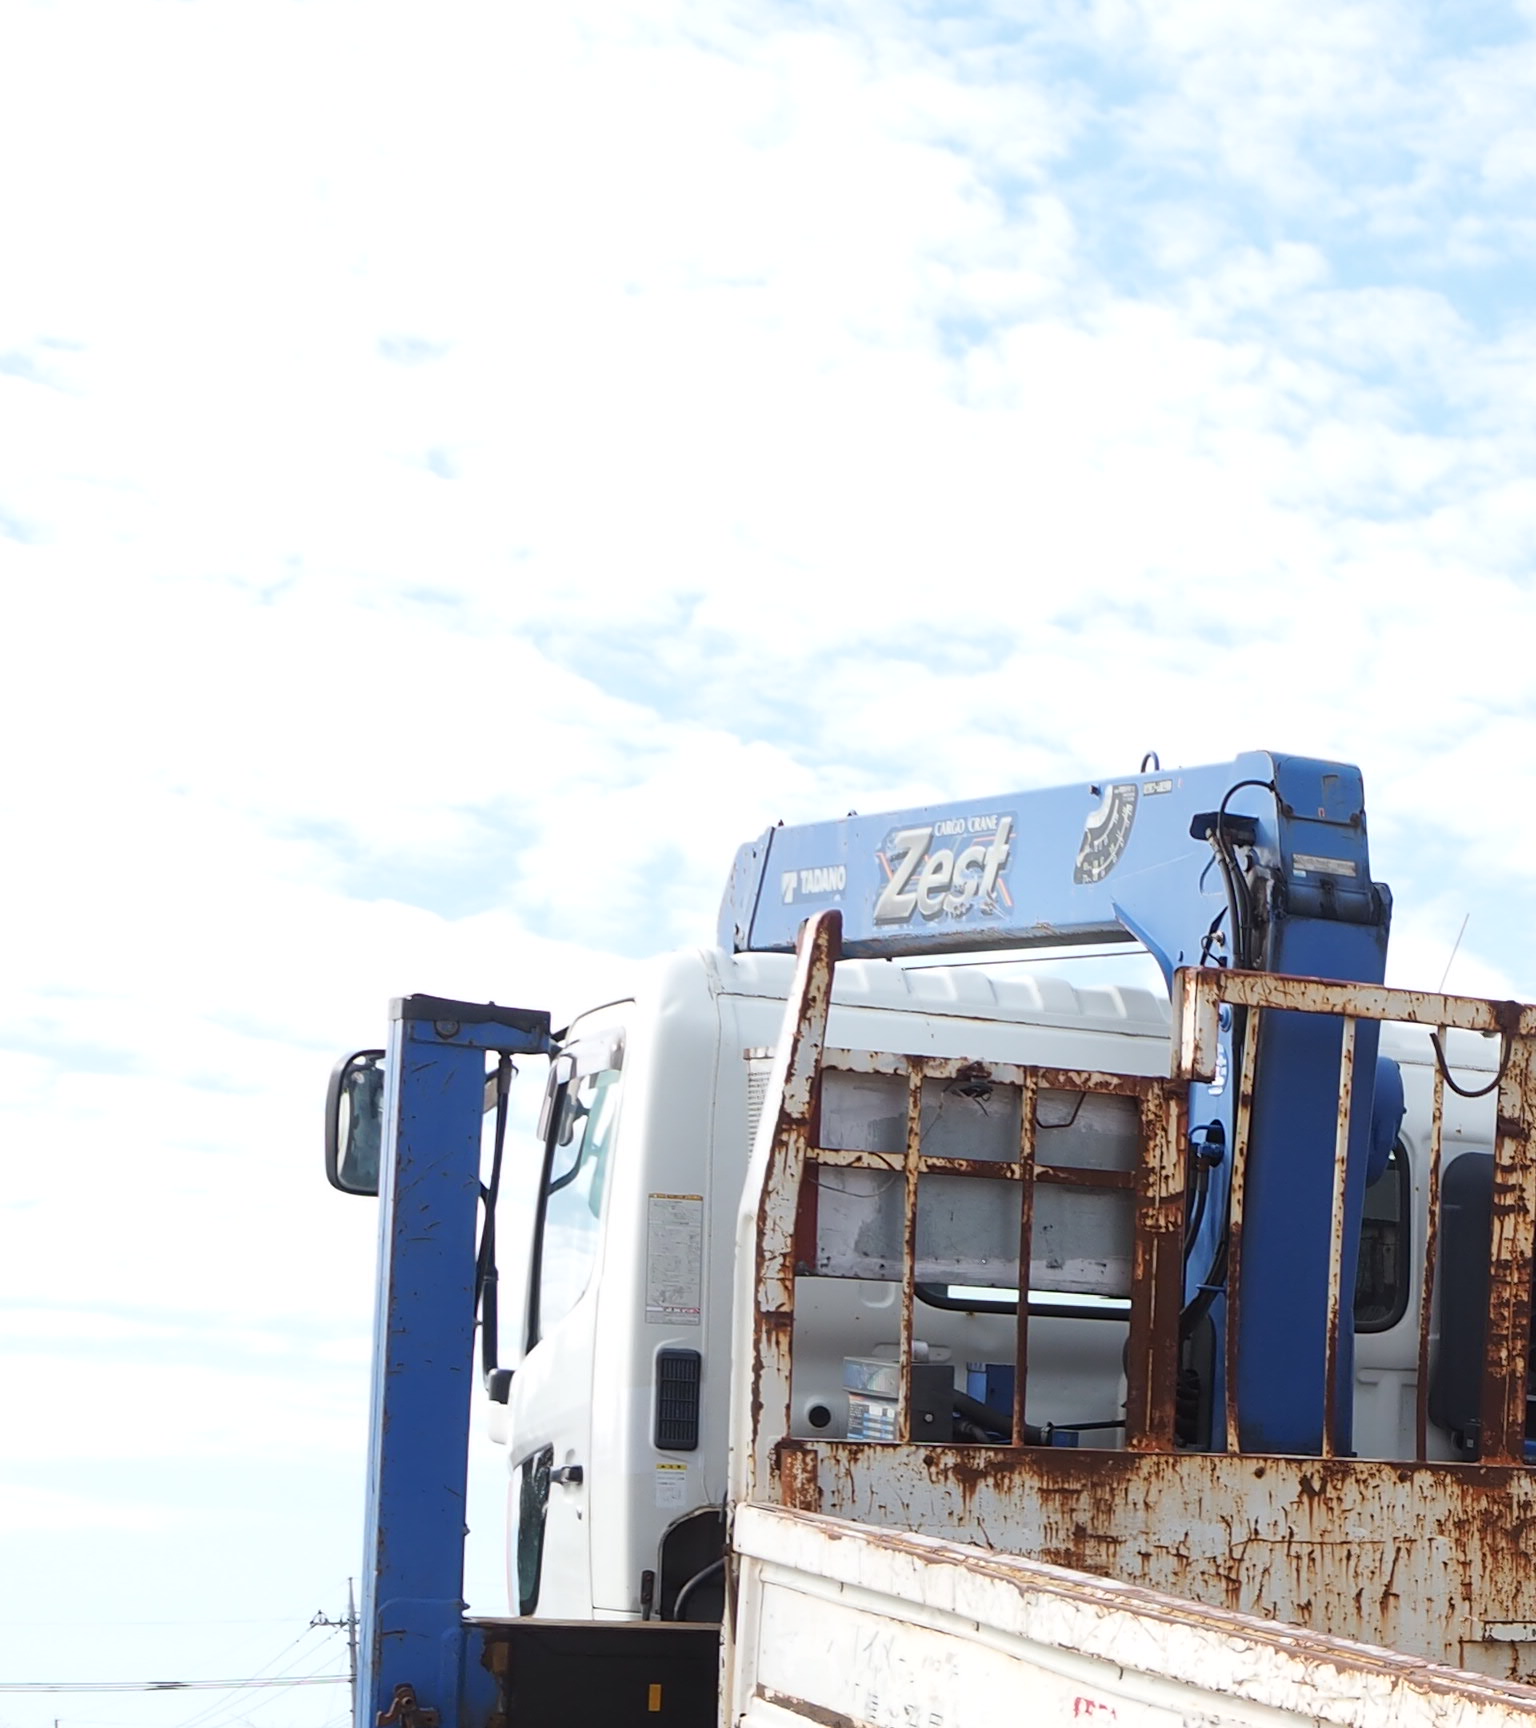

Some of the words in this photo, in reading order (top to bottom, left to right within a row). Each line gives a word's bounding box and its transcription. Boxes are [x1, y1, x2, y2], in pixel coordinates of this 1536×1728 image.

[934, 819, 966, 836] CARGO
[967, 815, 998, 832] CRANE
[800, 865, 847, 894] TADANO
[873, 816, 1013, 926] Zest
